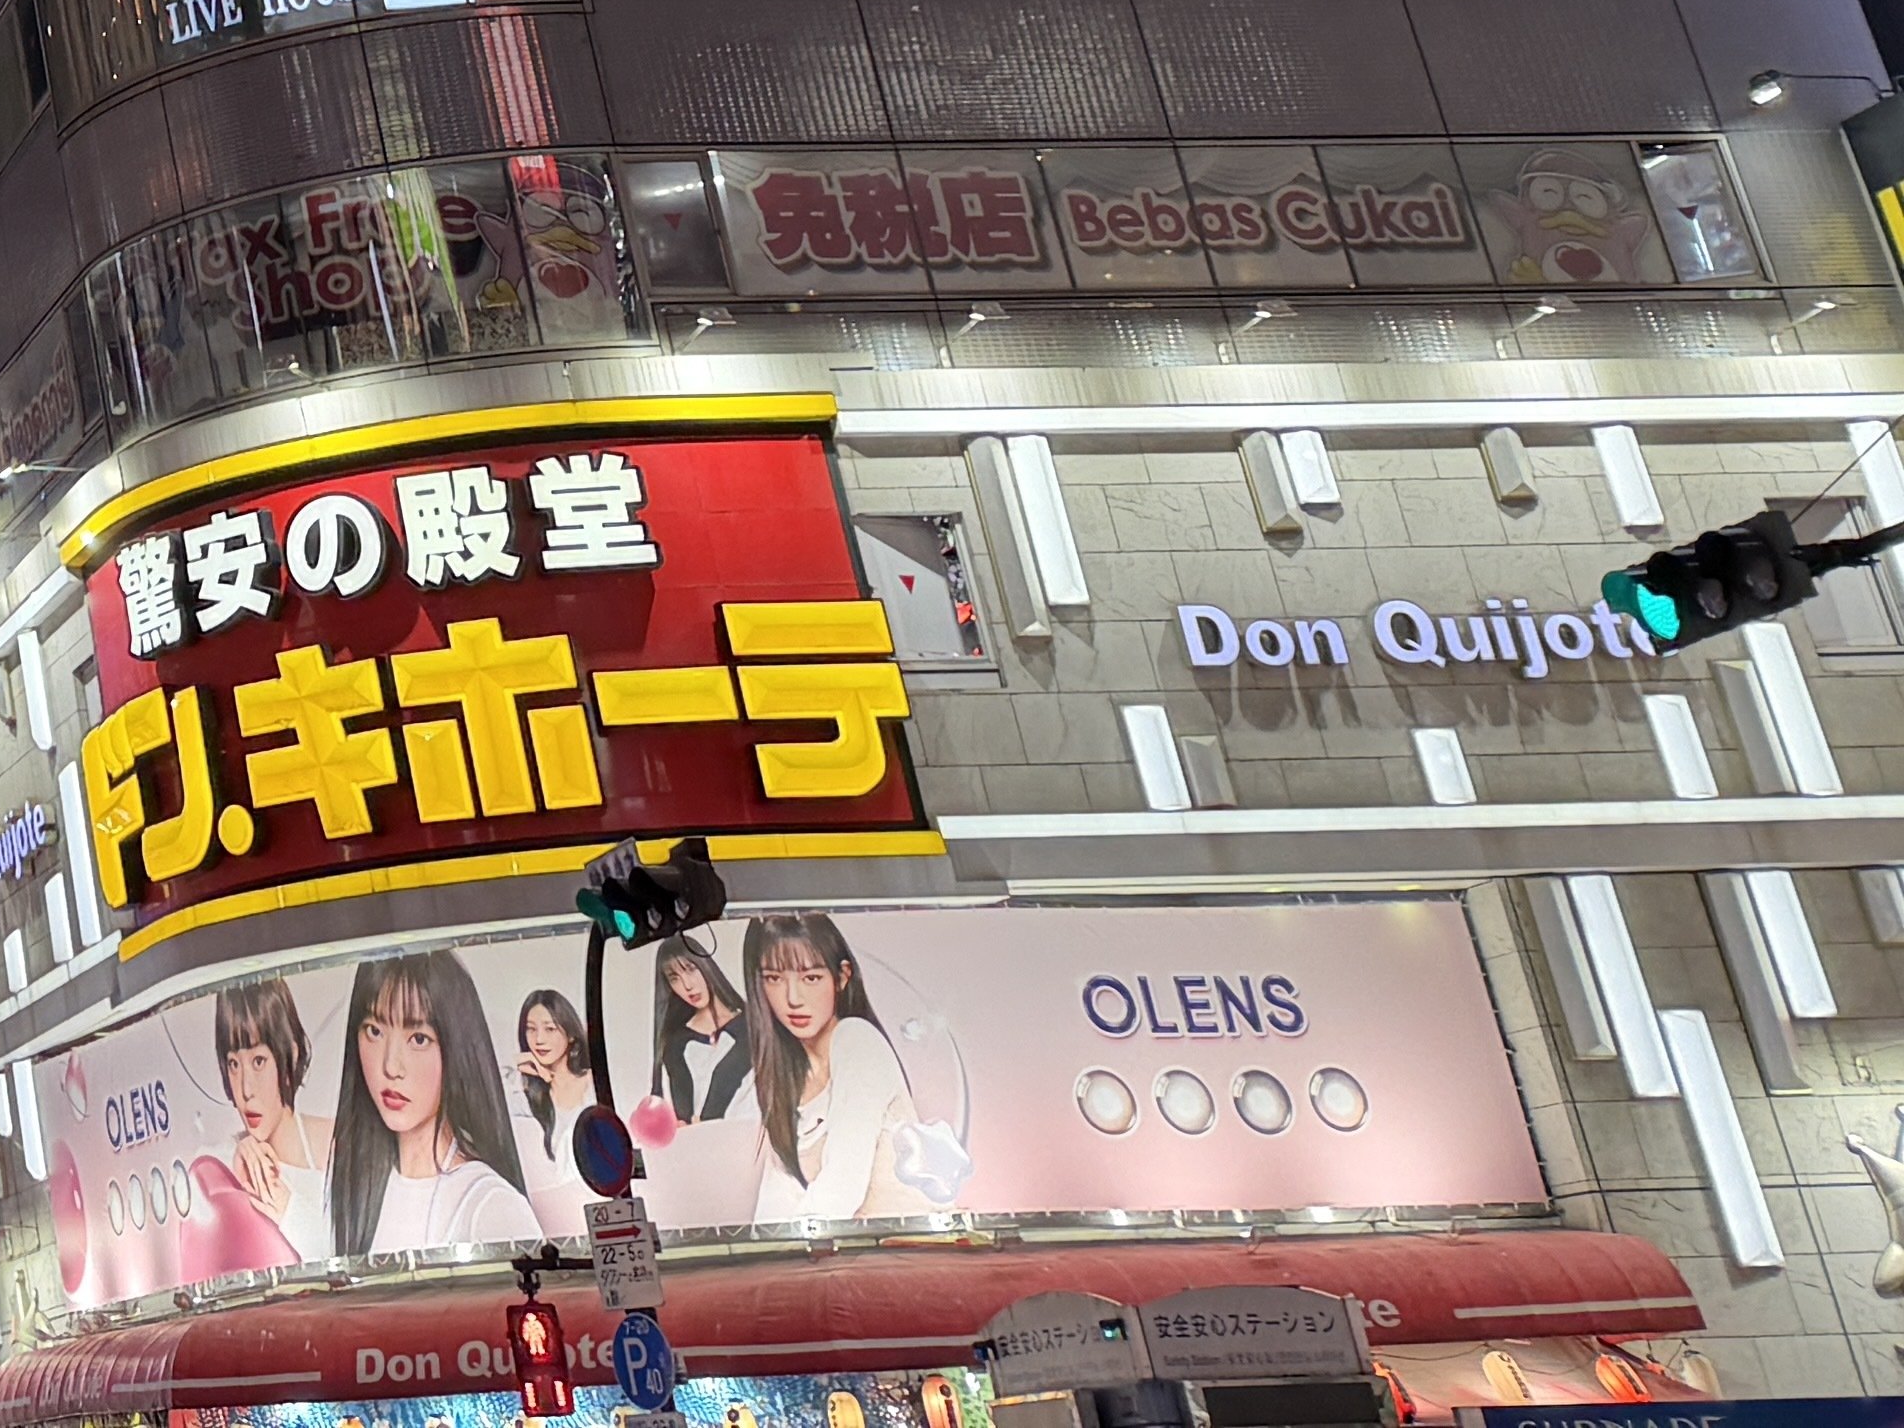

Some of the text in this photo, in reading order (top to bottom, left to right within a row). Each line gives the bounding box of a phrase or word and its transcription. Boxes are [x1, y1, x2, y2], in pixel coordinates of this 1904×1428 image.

[306, 193, 478, 250] Fre
[751, 167, 1033, 267] 免税店
[1066, 184, 1468, 246] Bebas Cukai
[115, 454, 659, 658] 驚安の殿堂
[1178, 603, 1347, 667] Don
[81, 600, 914, 908] ドン・キホーテ
[1081, 974, 1311, 1038] OLENS
[105, 1081, 171, 1155] OLENS
[1152, 1311, 1337, 1339] 安全安心ステーション
[357, 1337, 614, 1383] Don Quote
[623, 1337, 647, 1396] P
